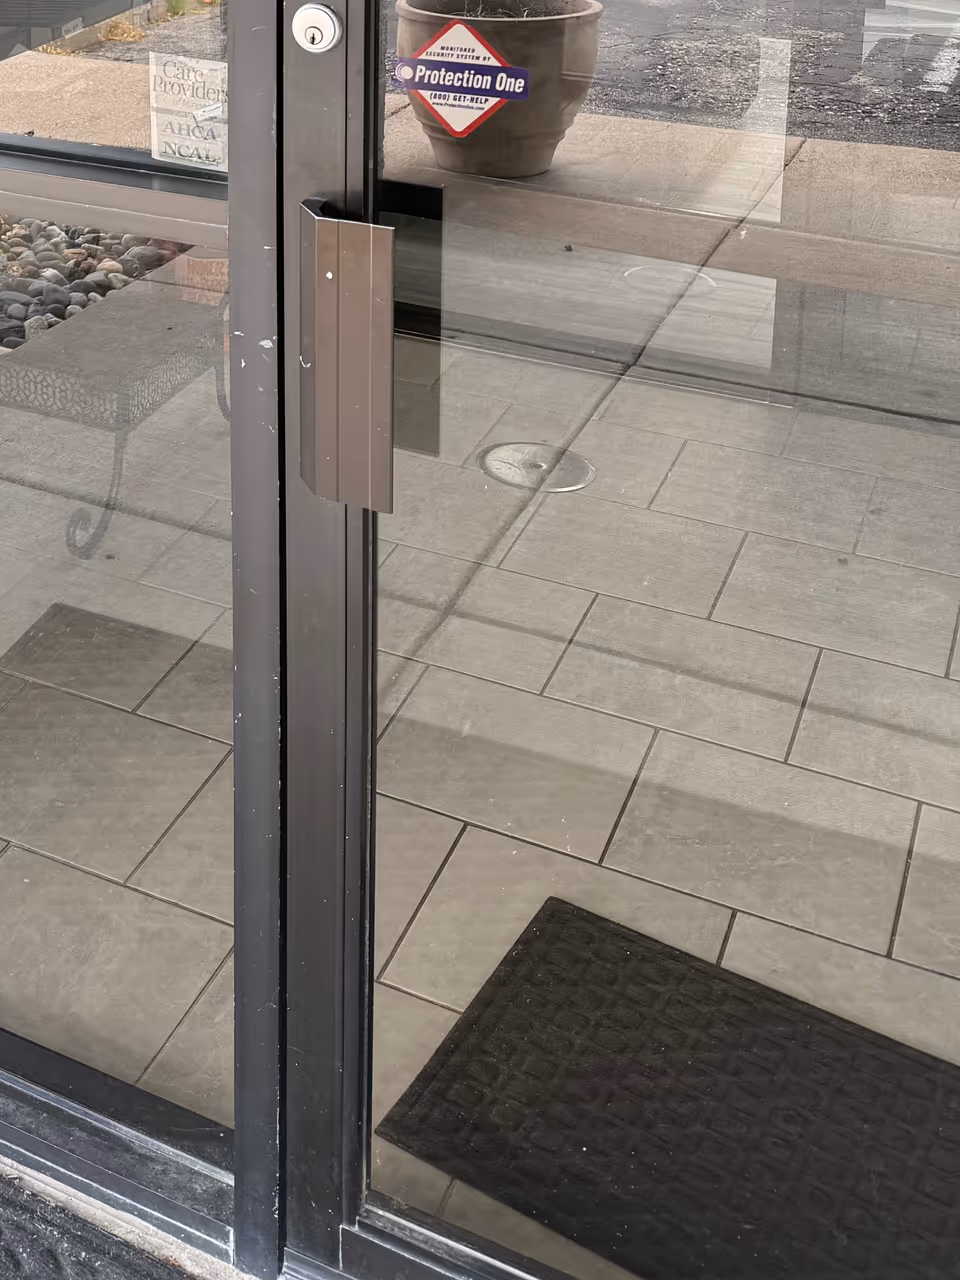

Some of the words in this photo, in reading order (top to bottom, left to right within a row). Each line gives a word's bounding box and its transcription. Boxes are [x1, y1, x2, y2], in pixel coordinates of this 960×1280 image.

[440, 45, 476, 54] MONITORED
[456, 53, 481, 61] SYSTEM
[163, 60, 204, 83] Care
[414, 65, 492, 90] Protection
[495, 72, 525, 93] One
[430, 92, 450, 101] (800)
[453, 93, 489, 105] GET-HELP
[162, 121, 216, 140] AHCA
